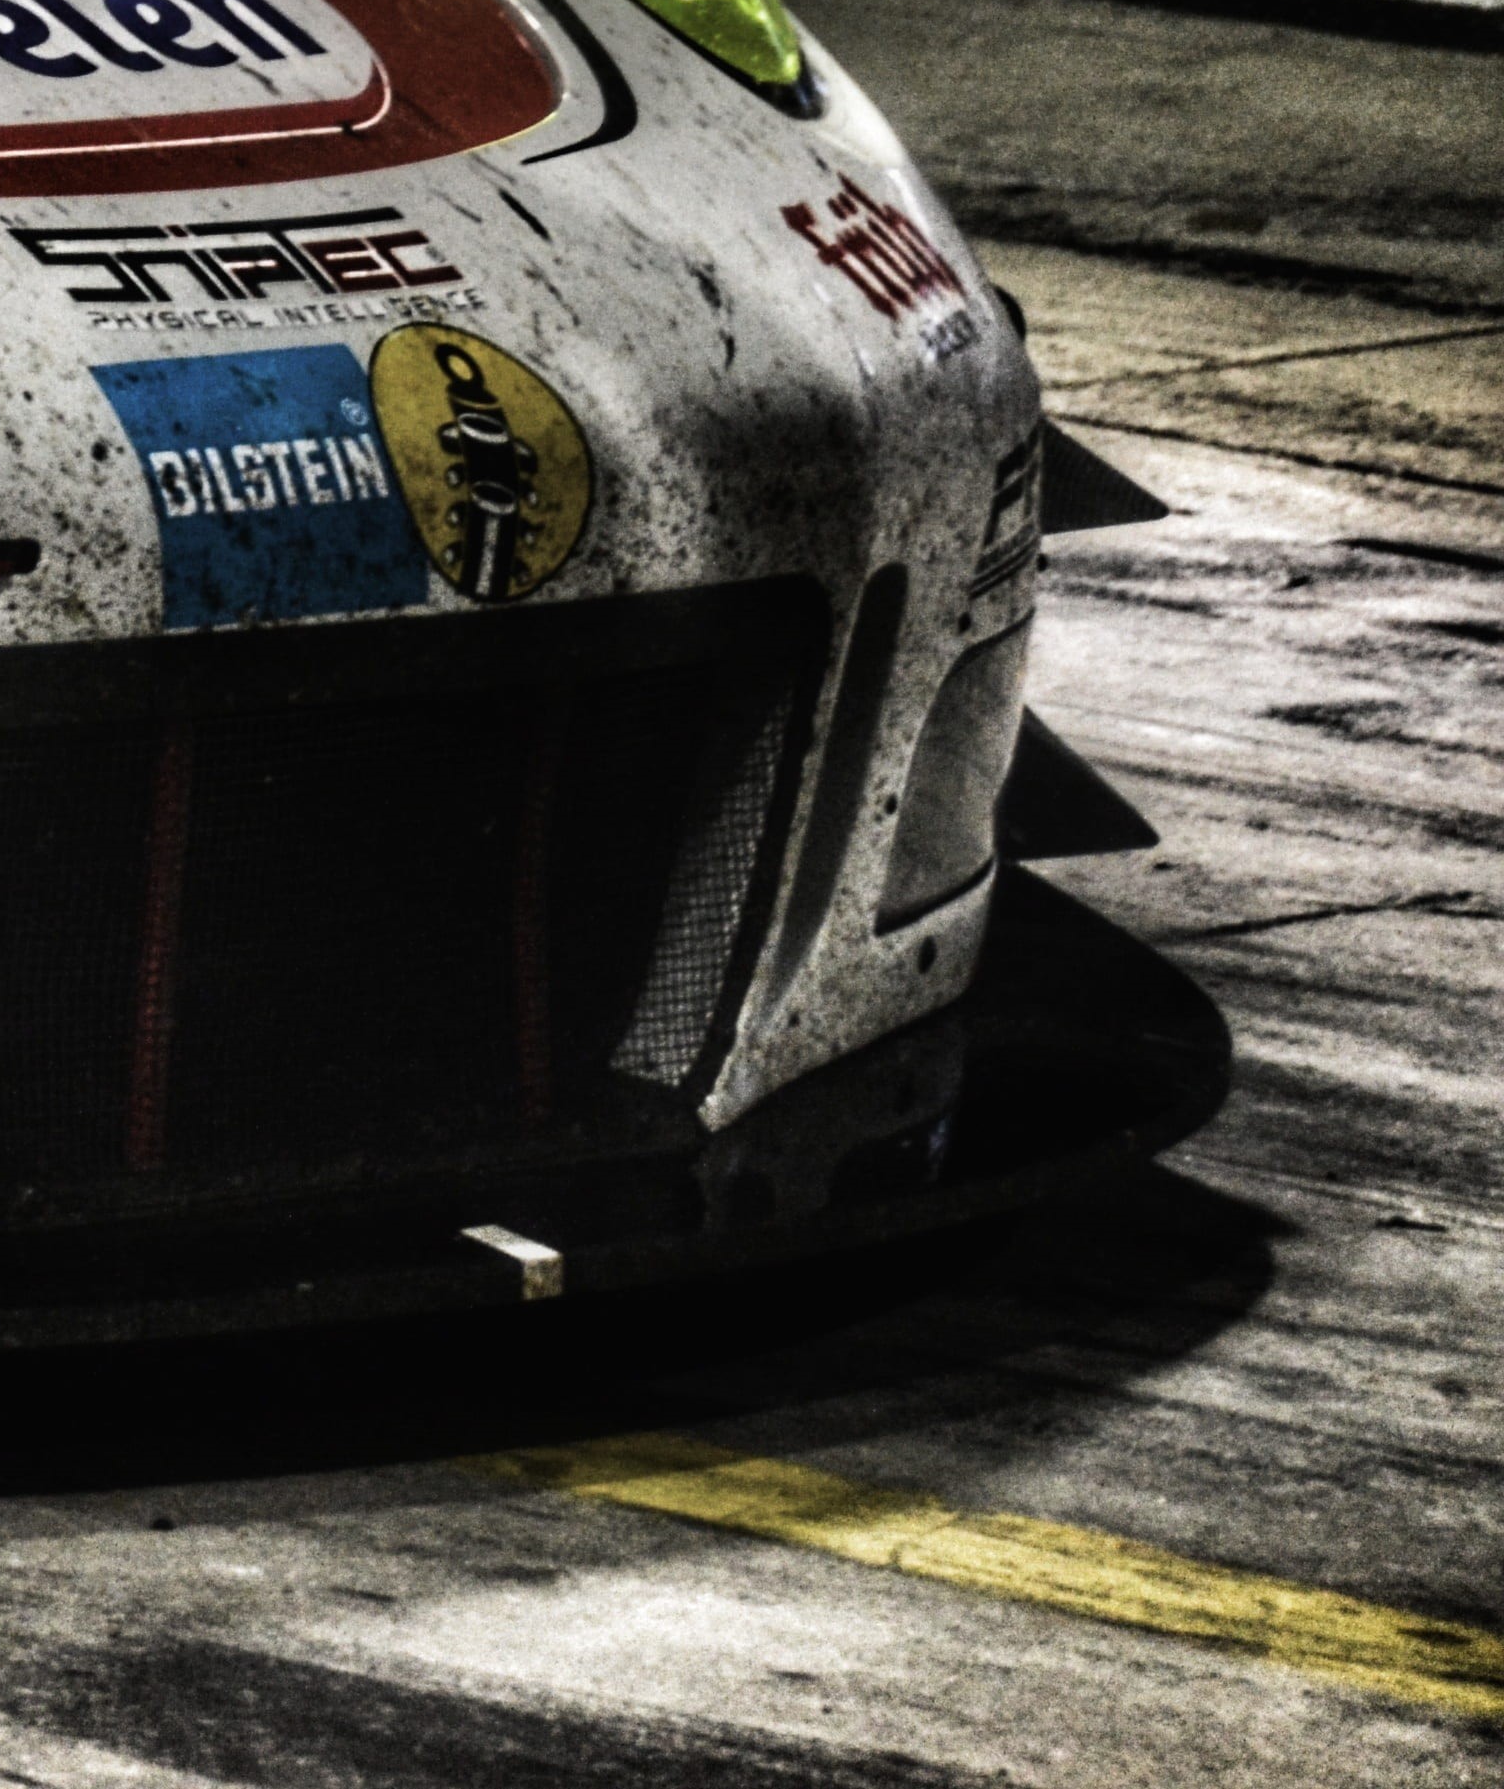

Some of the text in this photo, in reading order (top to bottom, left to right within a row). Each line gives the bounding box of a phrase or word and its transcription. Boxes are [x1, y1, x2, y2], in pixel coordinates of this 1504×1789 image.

[92, 287, 488, 331] PHYSICAL INTELLIGENCE
[148, 431, 390, 518] BILSTEIN
